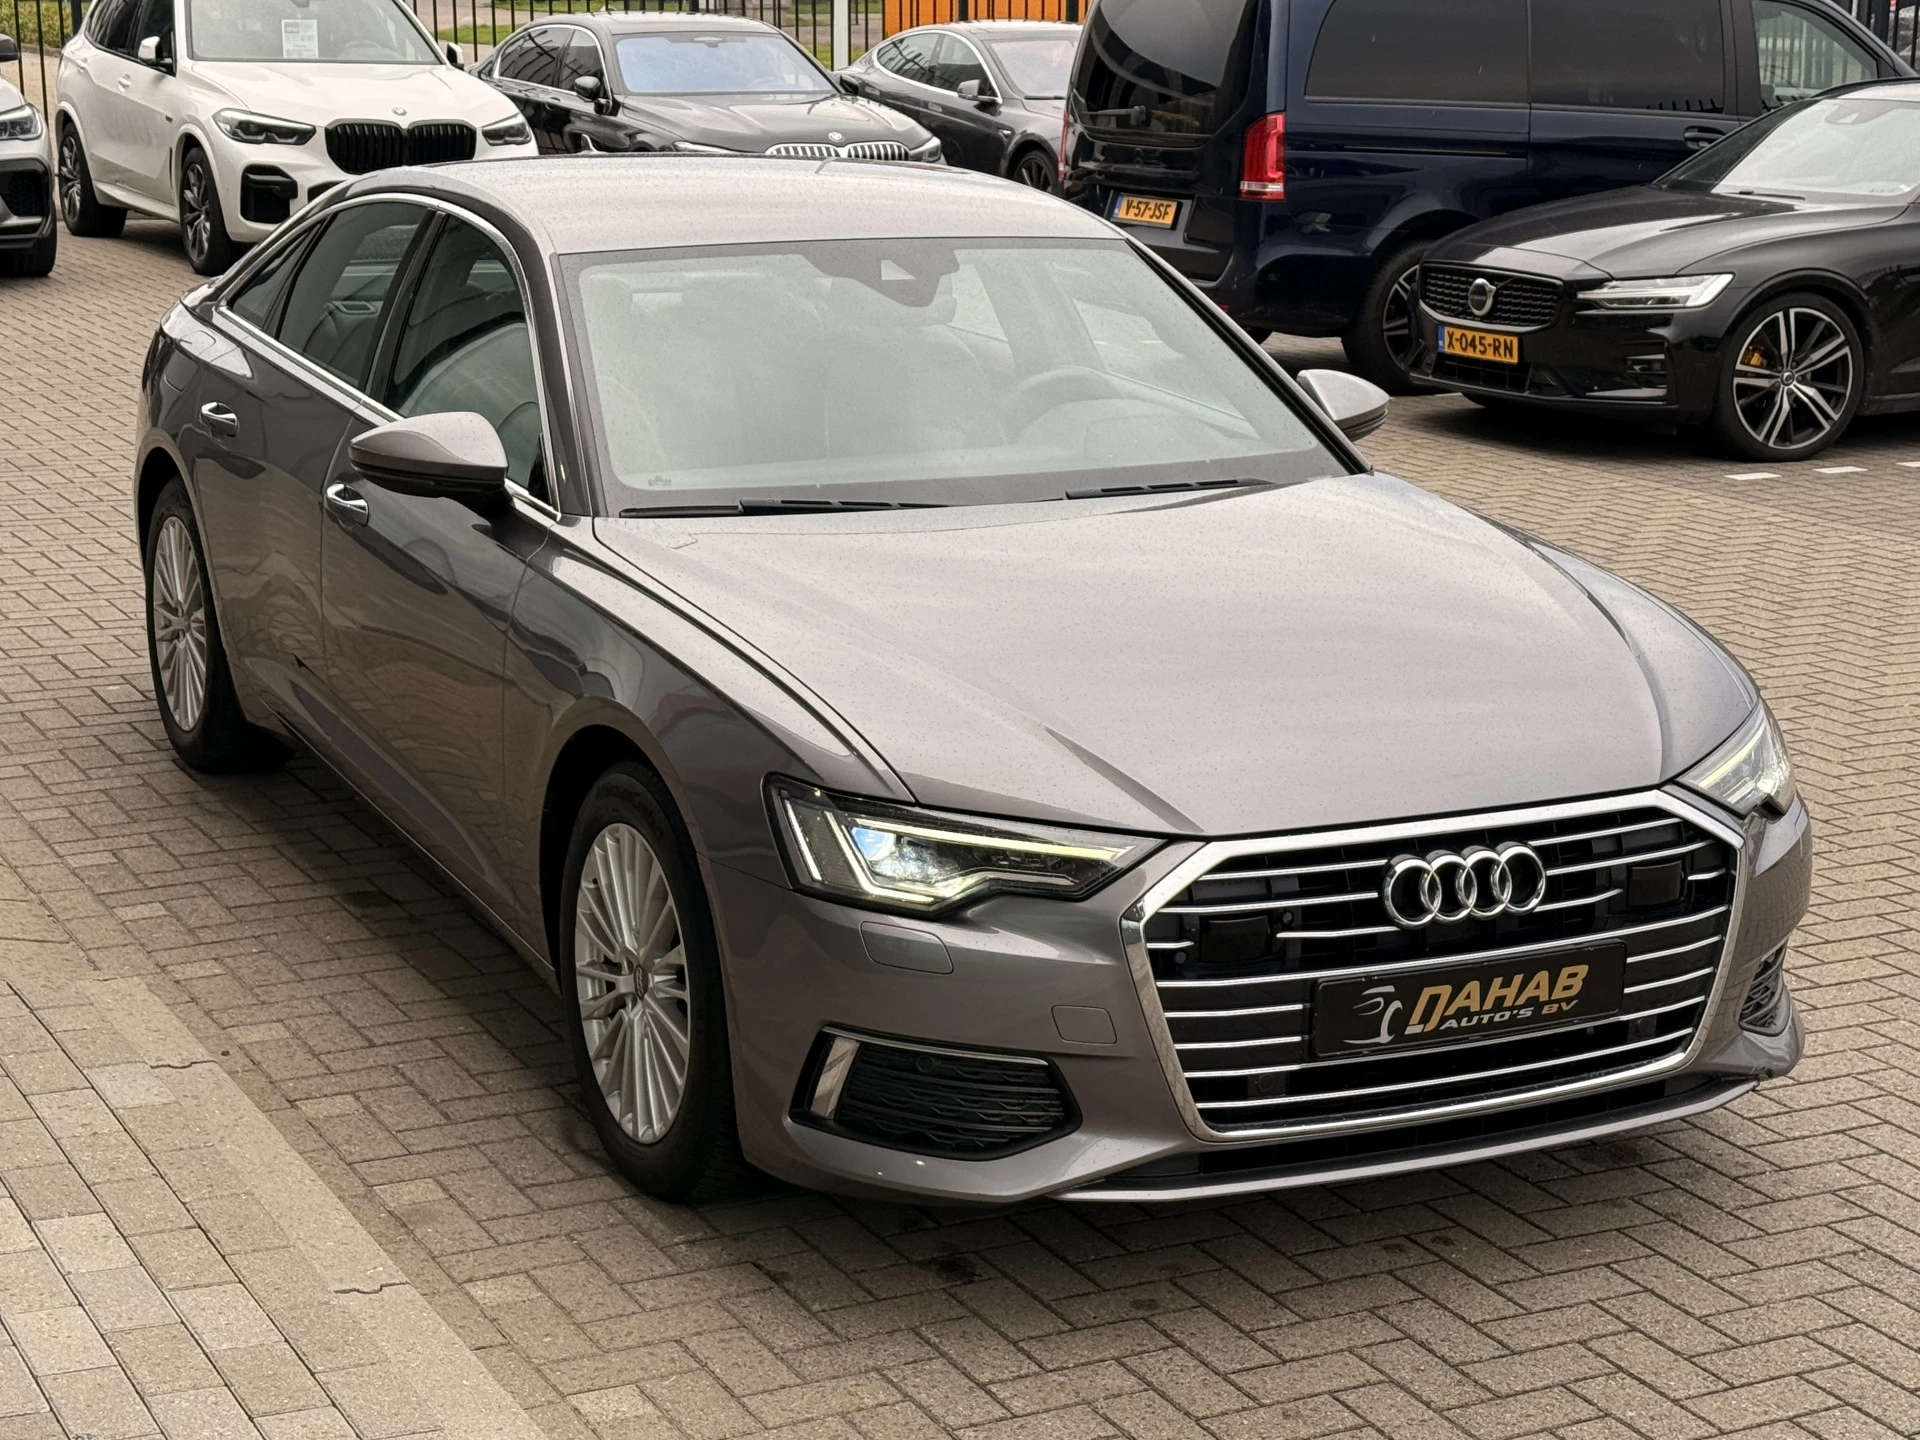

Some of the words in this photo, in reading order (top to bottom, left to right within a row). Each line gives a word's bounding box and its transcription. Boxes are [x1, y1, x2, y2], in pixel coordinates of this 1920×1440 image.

[1125, 198, 1172, 220] V-57-JSF
[1447, 330, 1514, 359] X-045-RN
[1404, 964, 1589, 1034] DAHAB
[1439, 1006, 1534, 1030] AUTO'S
[1541, 1000, 1579, 1015] BV
